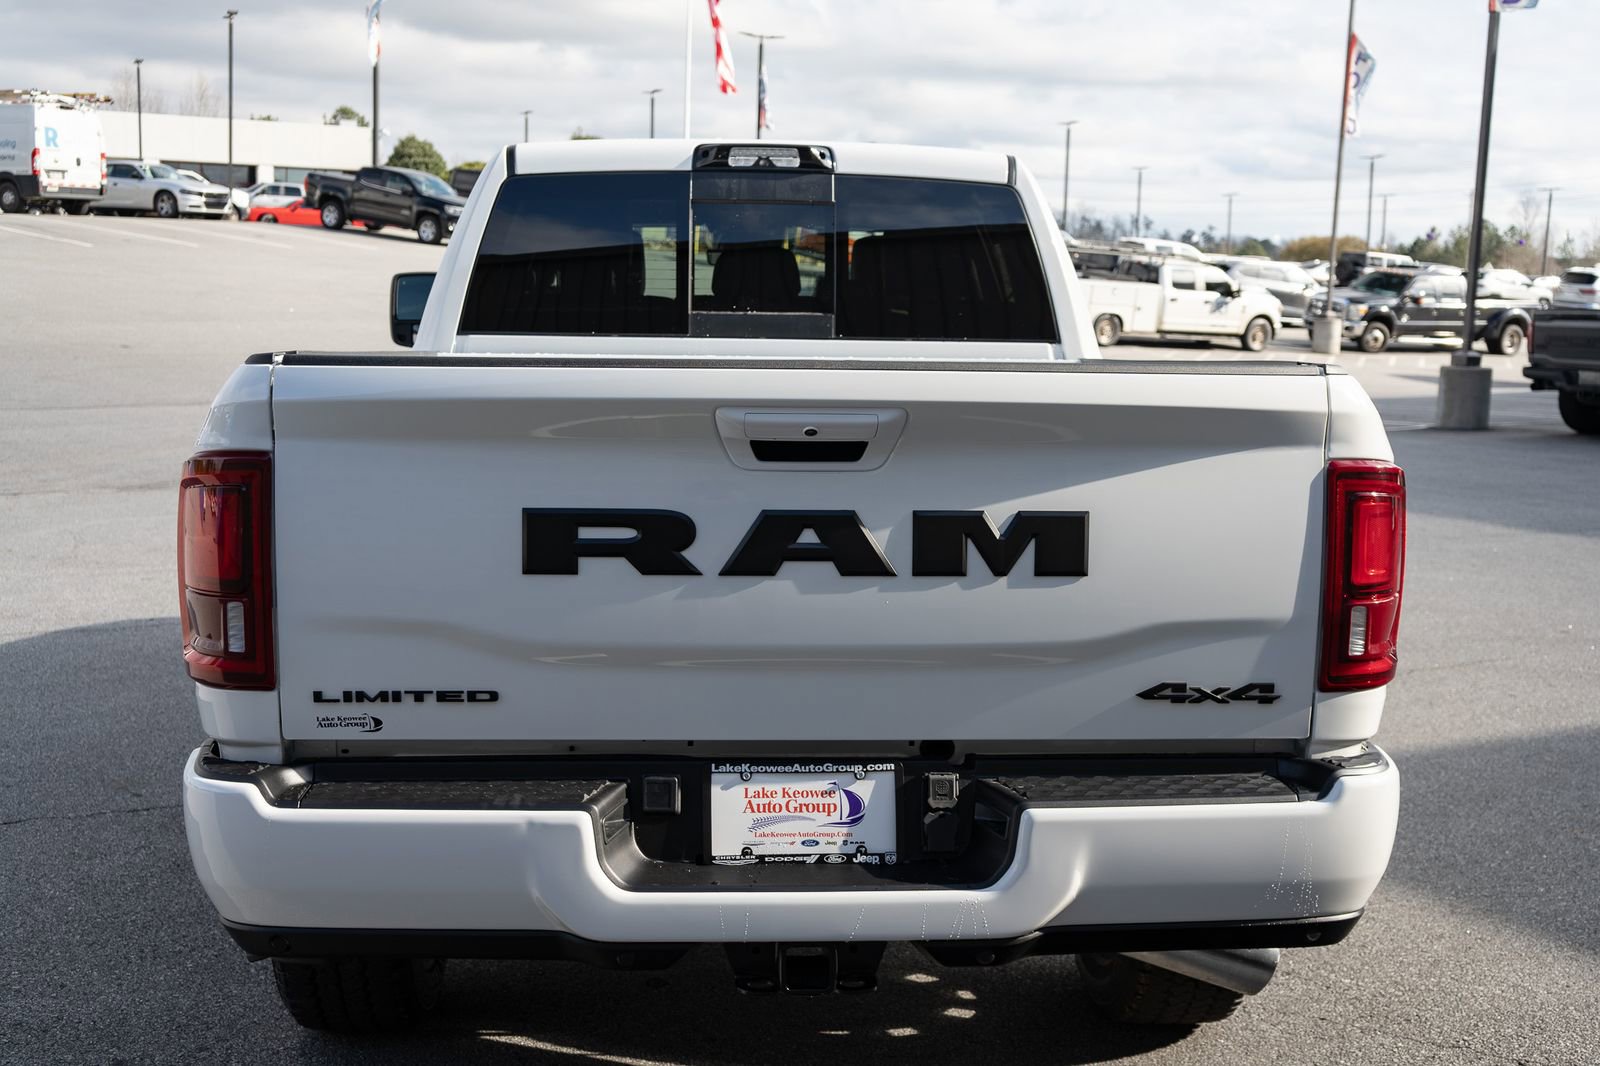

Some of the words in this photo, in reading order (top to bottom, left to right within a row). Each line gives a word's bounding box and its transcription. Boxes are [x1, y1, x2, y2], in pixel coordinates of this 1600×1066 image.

[44, 127, 59, 148] R
[522, 507, 1090, 577] RAM
[313, 690, 500, 703] LIMITED
[1135, 682, 1282, 704] 4x4
[316, 721, 339, 729] Auto
[339, 721, 369, 730] Group
[711, 762, 895, 774] LakeKeoweeAutoGroup.com
[744, 787, 778, 799] Lake
[782, 787, 836, 799] Keowee
[743, 799, 782, 814] Auto
[785, 799, 838, 817] Group
[754, 831, 853, 839] LakeKeoweeAutoGroup.Com
[826, 855, 844, 863] Ford
[853, 853, 879, 865] Jeep
